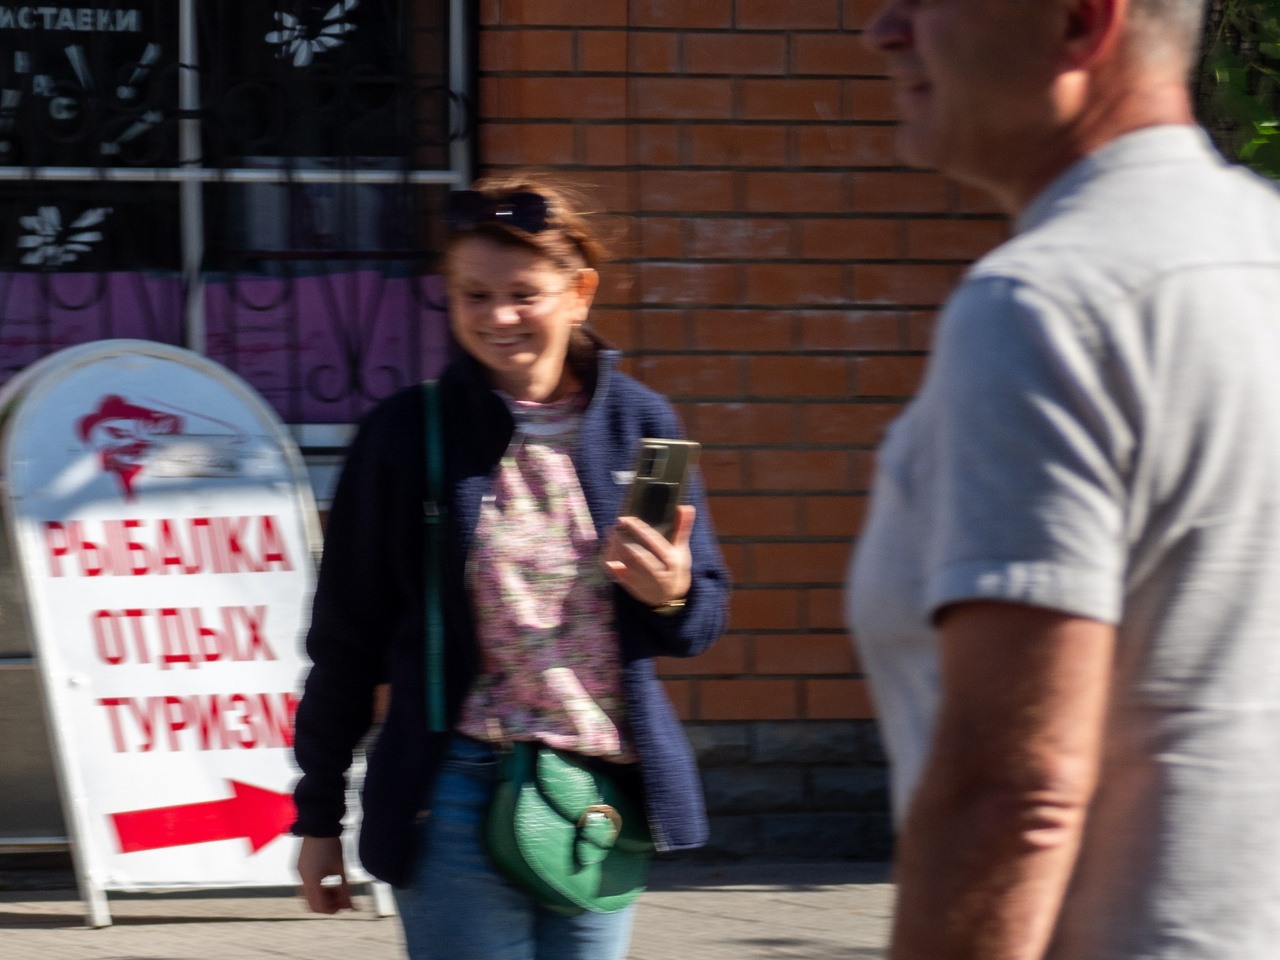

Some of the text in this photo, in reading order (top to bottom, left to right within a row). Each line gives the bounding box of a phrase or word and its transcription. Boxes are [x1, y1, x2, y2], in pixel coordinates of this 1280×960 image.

[43, 515, 295, 578] РЫБАЛКА
[90, 605, 278, 670] ОТДЫХ
[97, 692, 299, 753] ТУРИЗМ
